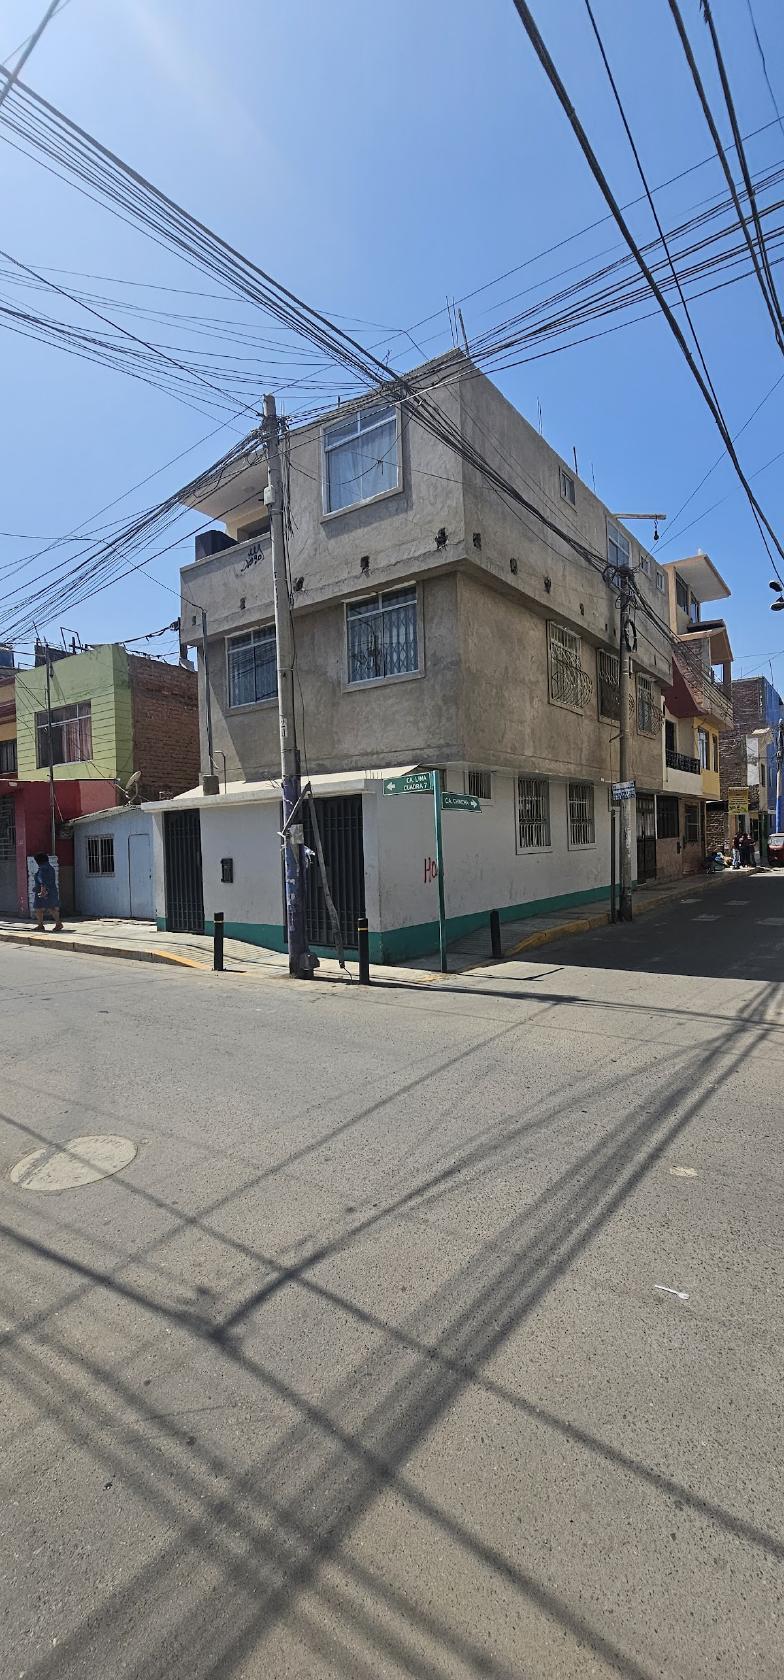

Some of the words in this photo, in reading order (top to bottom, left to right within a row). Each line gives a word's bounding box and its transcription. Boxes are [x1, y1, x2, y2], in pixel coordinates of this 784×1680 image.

[406, 776, 414, 784] CA.
[415, 775, 427, 783] LIMA
[403, 783, 423, 791] CUADRA
